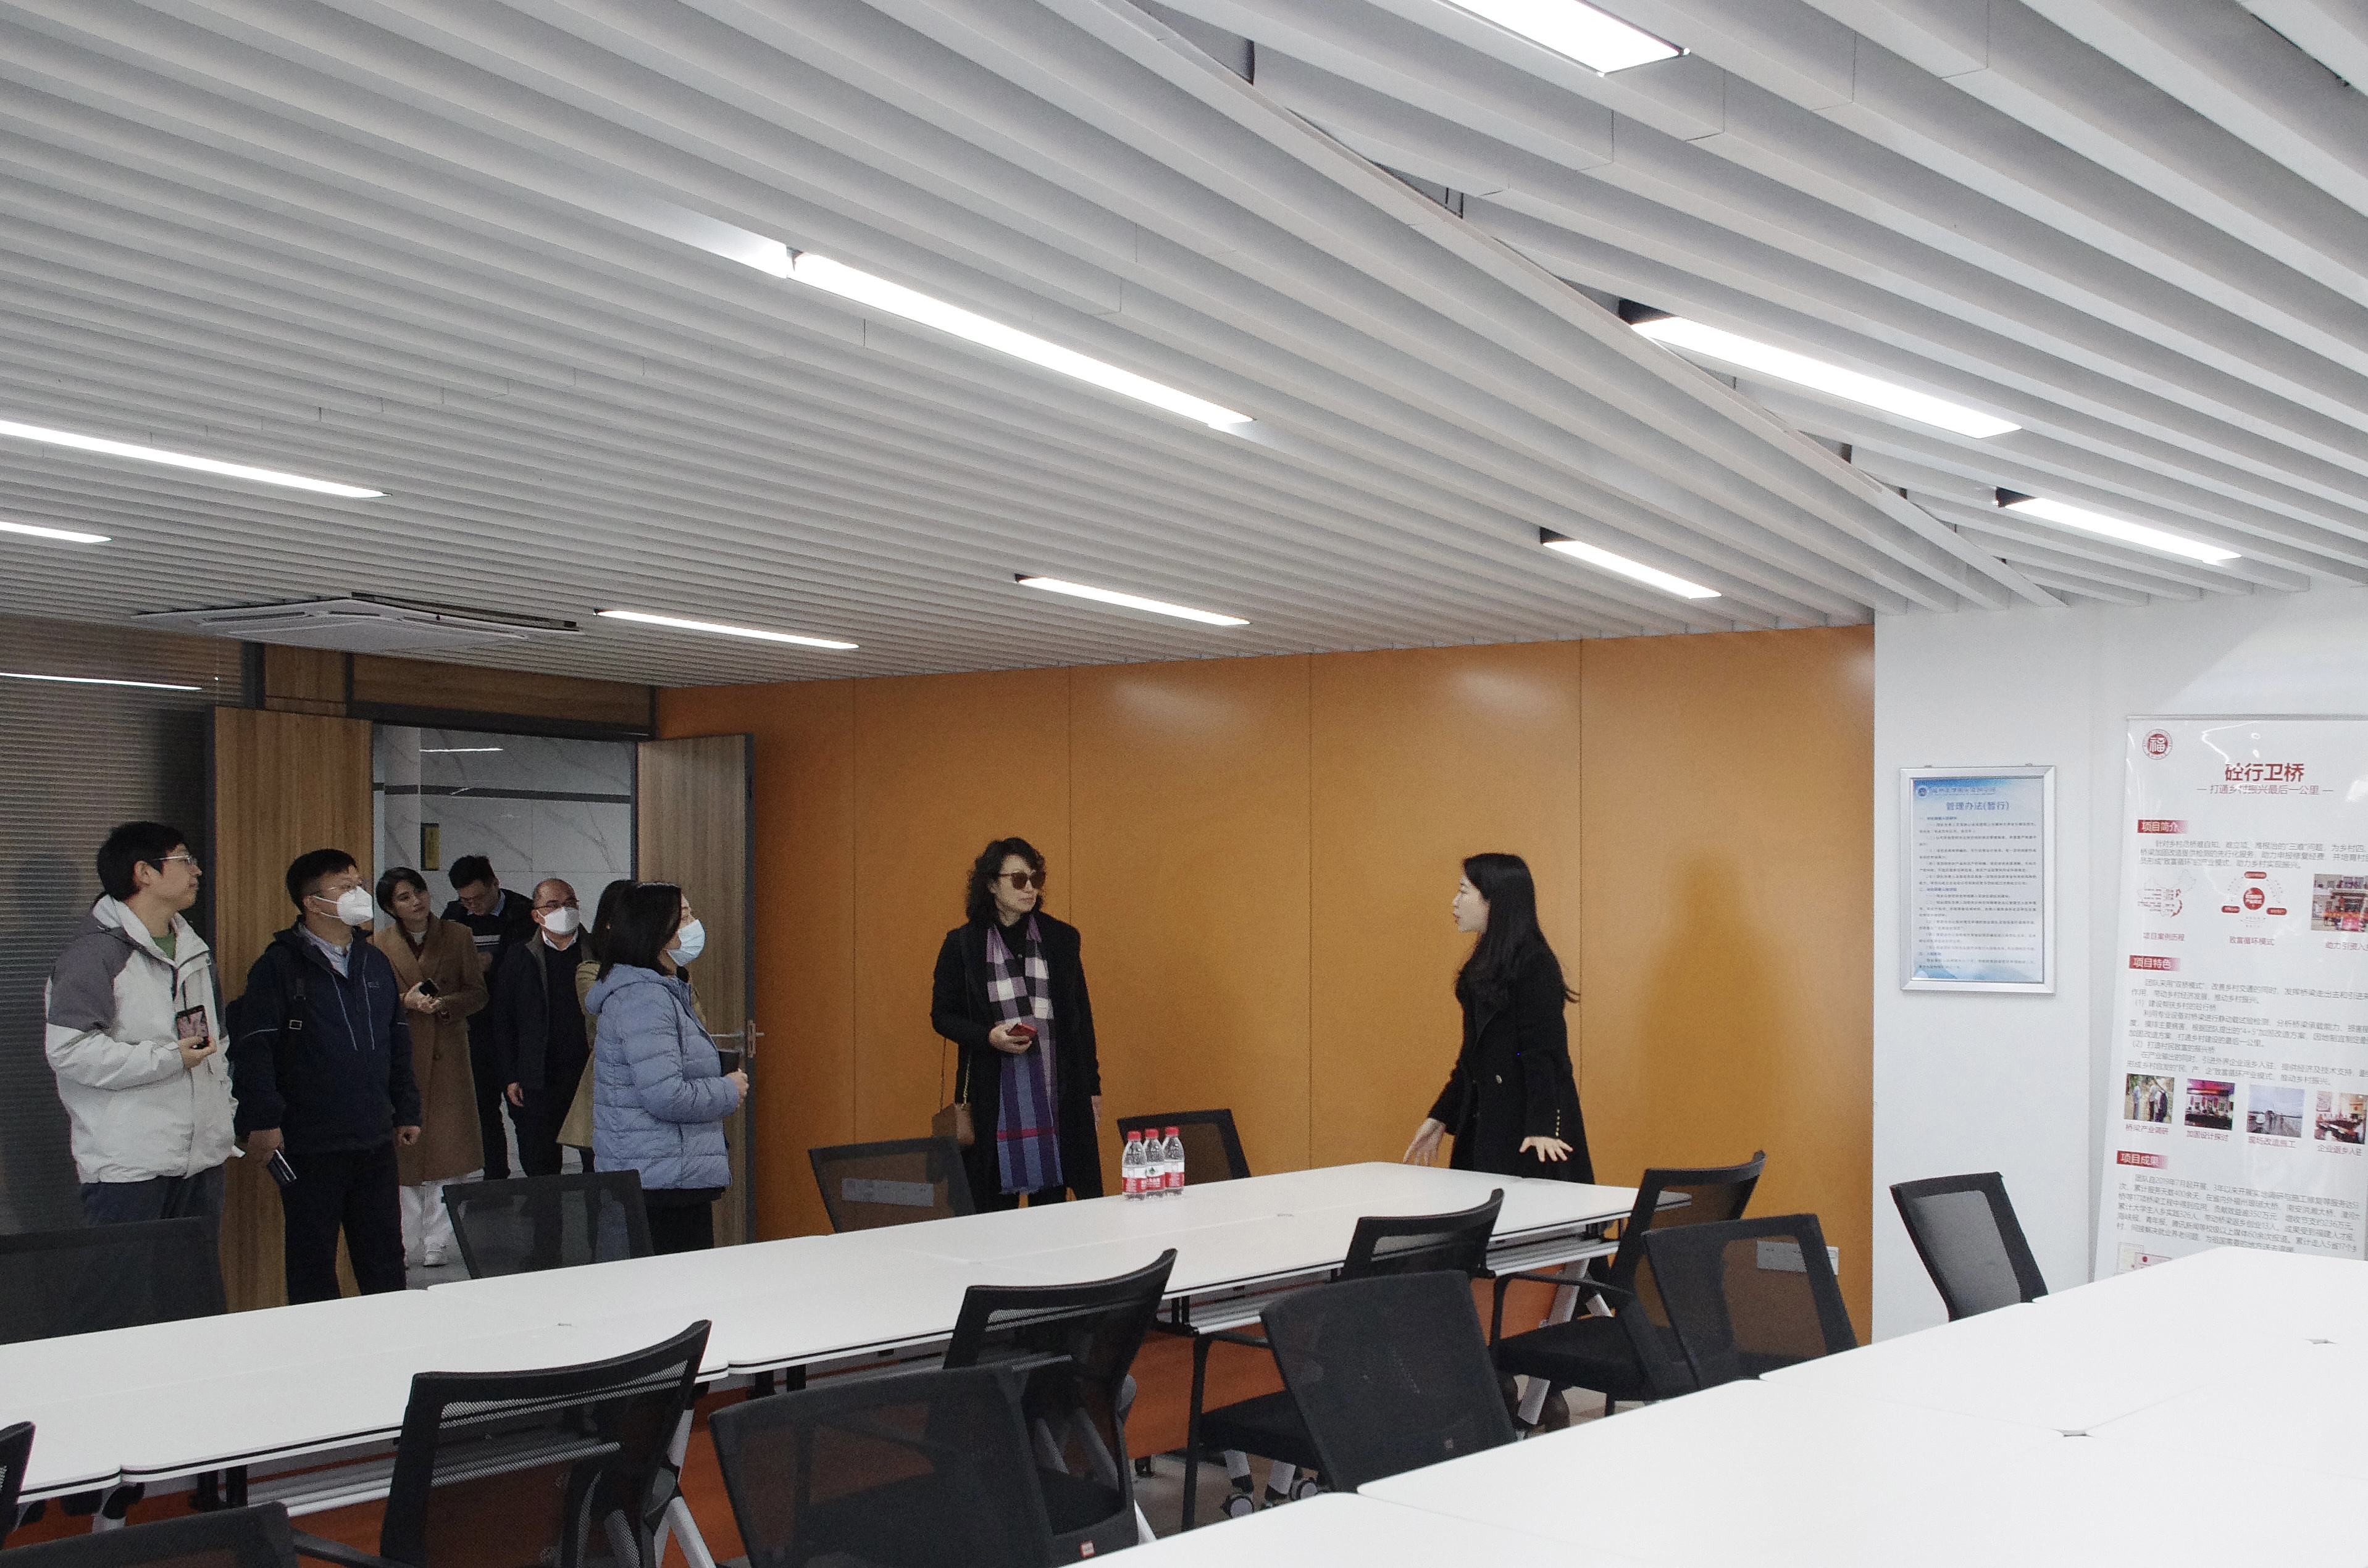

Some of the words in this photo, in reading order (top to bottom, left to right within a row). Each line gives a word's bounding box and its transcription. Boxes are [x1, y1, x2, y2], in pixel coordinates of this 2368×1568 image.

[2150, 736, 2165, 754] 福
[2141, 822, 2178, 832] 项目简介
[2229, 936, 2275, 946] 致富循环模式
[2133, 957, 2172, 969] 项目特色
[2121, 1154, 2159, 1166] 项目成果
